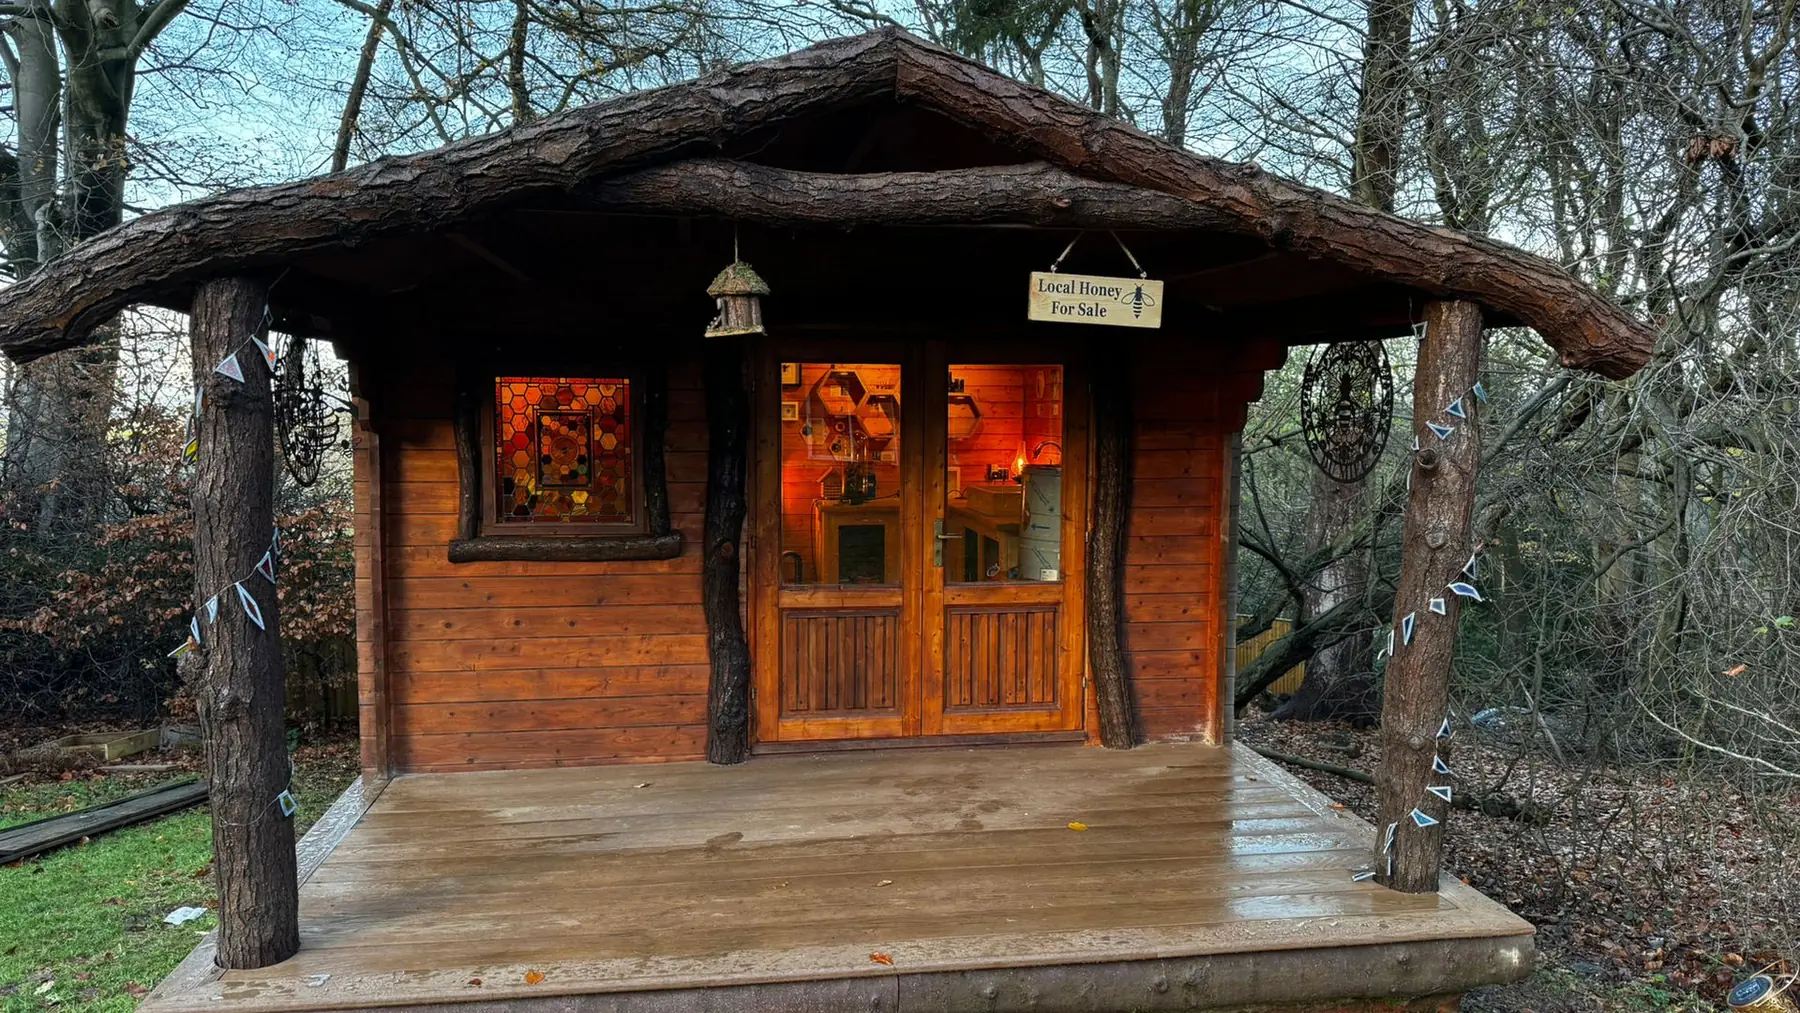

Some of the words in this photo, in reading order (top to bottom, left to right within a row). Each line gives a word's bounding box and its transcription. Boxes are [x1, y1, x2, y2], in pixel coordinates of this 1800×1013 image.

[1038, 278, 1075, 294] Local
[1079, 281, 1123, 300] Honey
[1051, 301, 1075, 315] For
[1077, 302, 1107, 317] Sale
